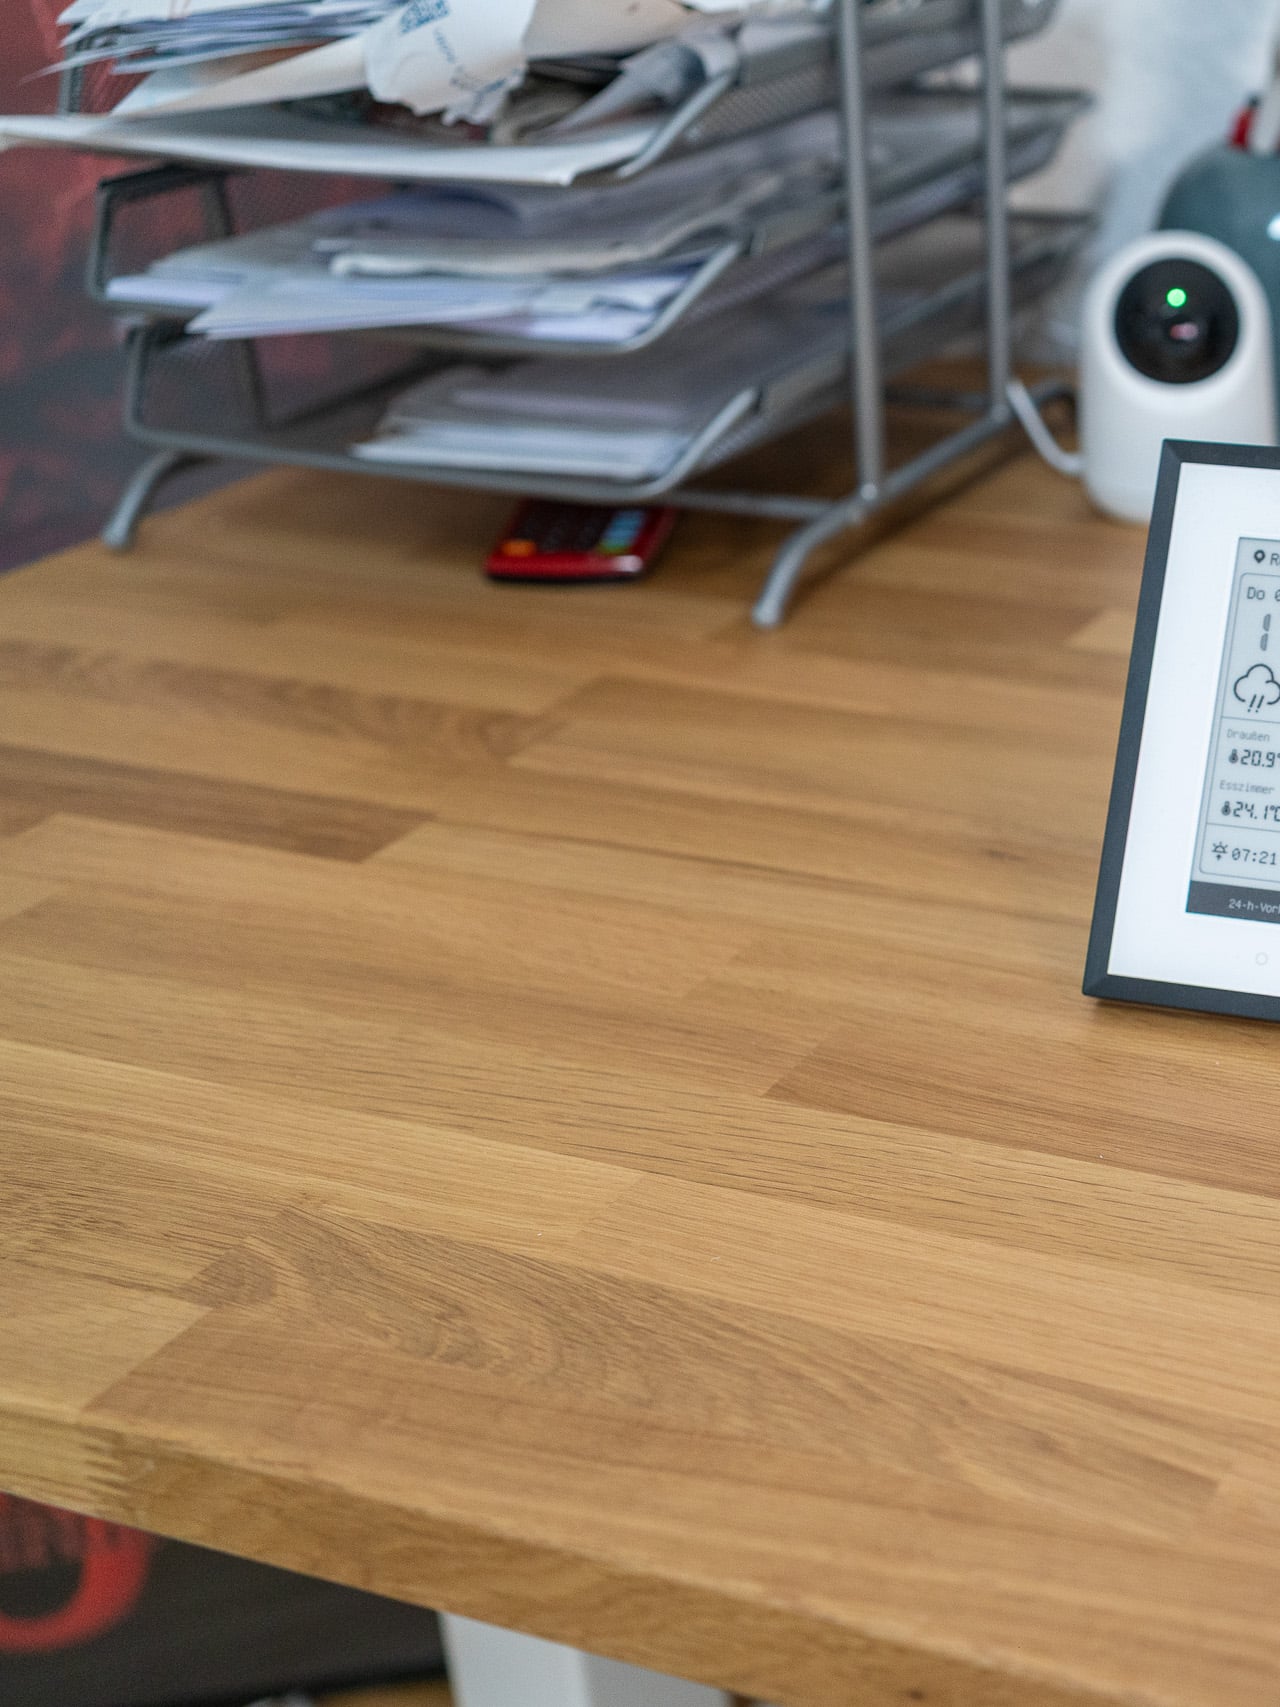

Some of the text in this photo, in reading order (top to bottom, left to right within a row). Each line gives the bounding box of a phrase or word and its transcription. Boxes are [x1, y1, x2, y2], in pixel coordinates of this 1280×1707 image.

[1246, 586, 1266, 601] Do
[1226, 728, 1271, 743] Draußen
[1219, 779, 1275, 795] Esszimmer
[1231, 847, 1278, 866] 07:21
